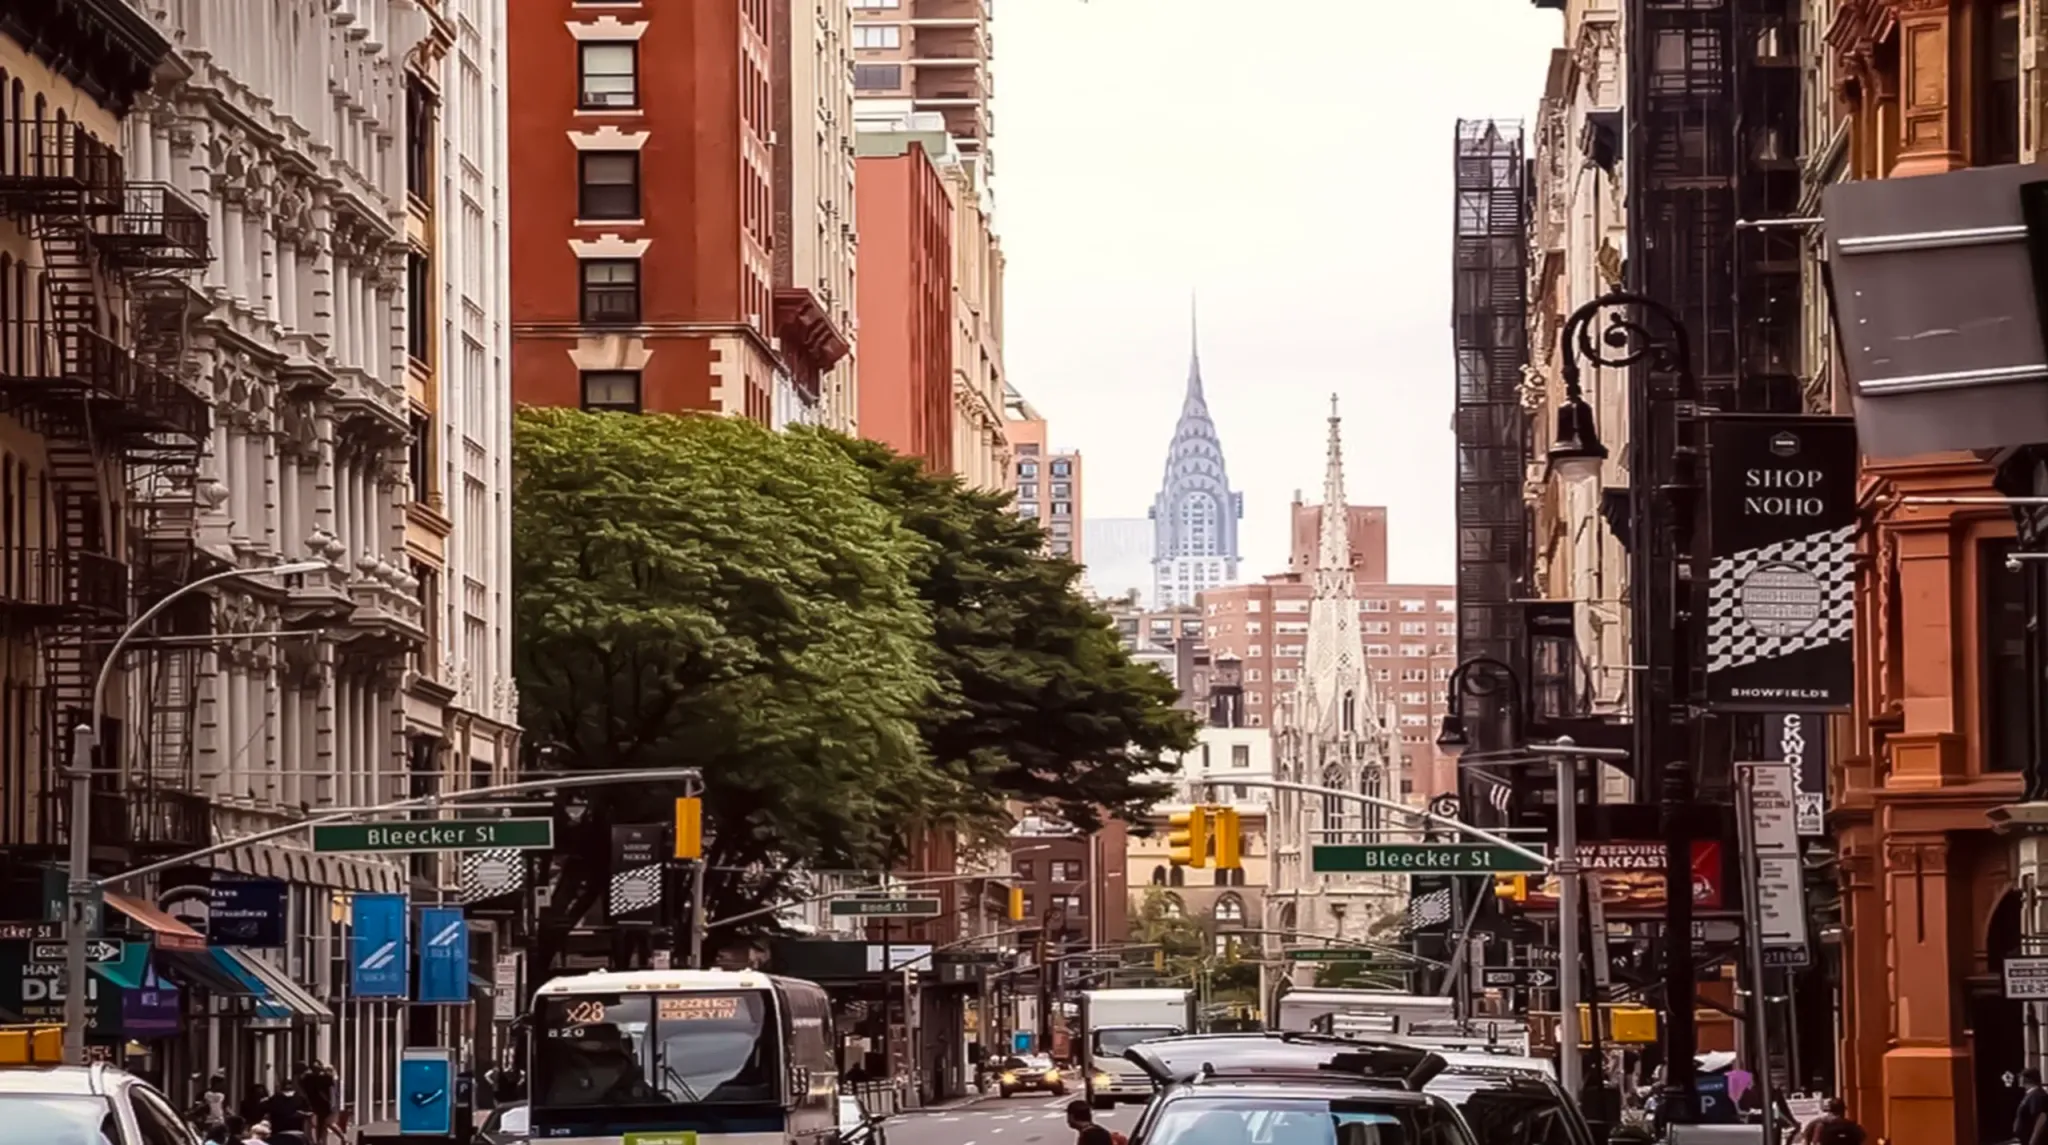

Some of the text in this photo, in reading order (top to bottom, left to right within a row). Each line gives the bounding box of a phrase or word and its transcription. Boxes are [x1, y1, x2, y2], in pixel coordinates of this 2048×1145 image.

[1745, 469, 1823, 488] SHOP
[1744, 497, 1824, 516] NOHO
[1730, 687, 1829, 698] SHOWFIELDS
[367, 826, 496, 845] Bleecker St
[1365, 850, 1492, 867] Bleecker St
[1576, 856, 1668, 868] EAKFAST
[38, 925, 51, 938] St
[22, 978, 98, 1000] DEI
